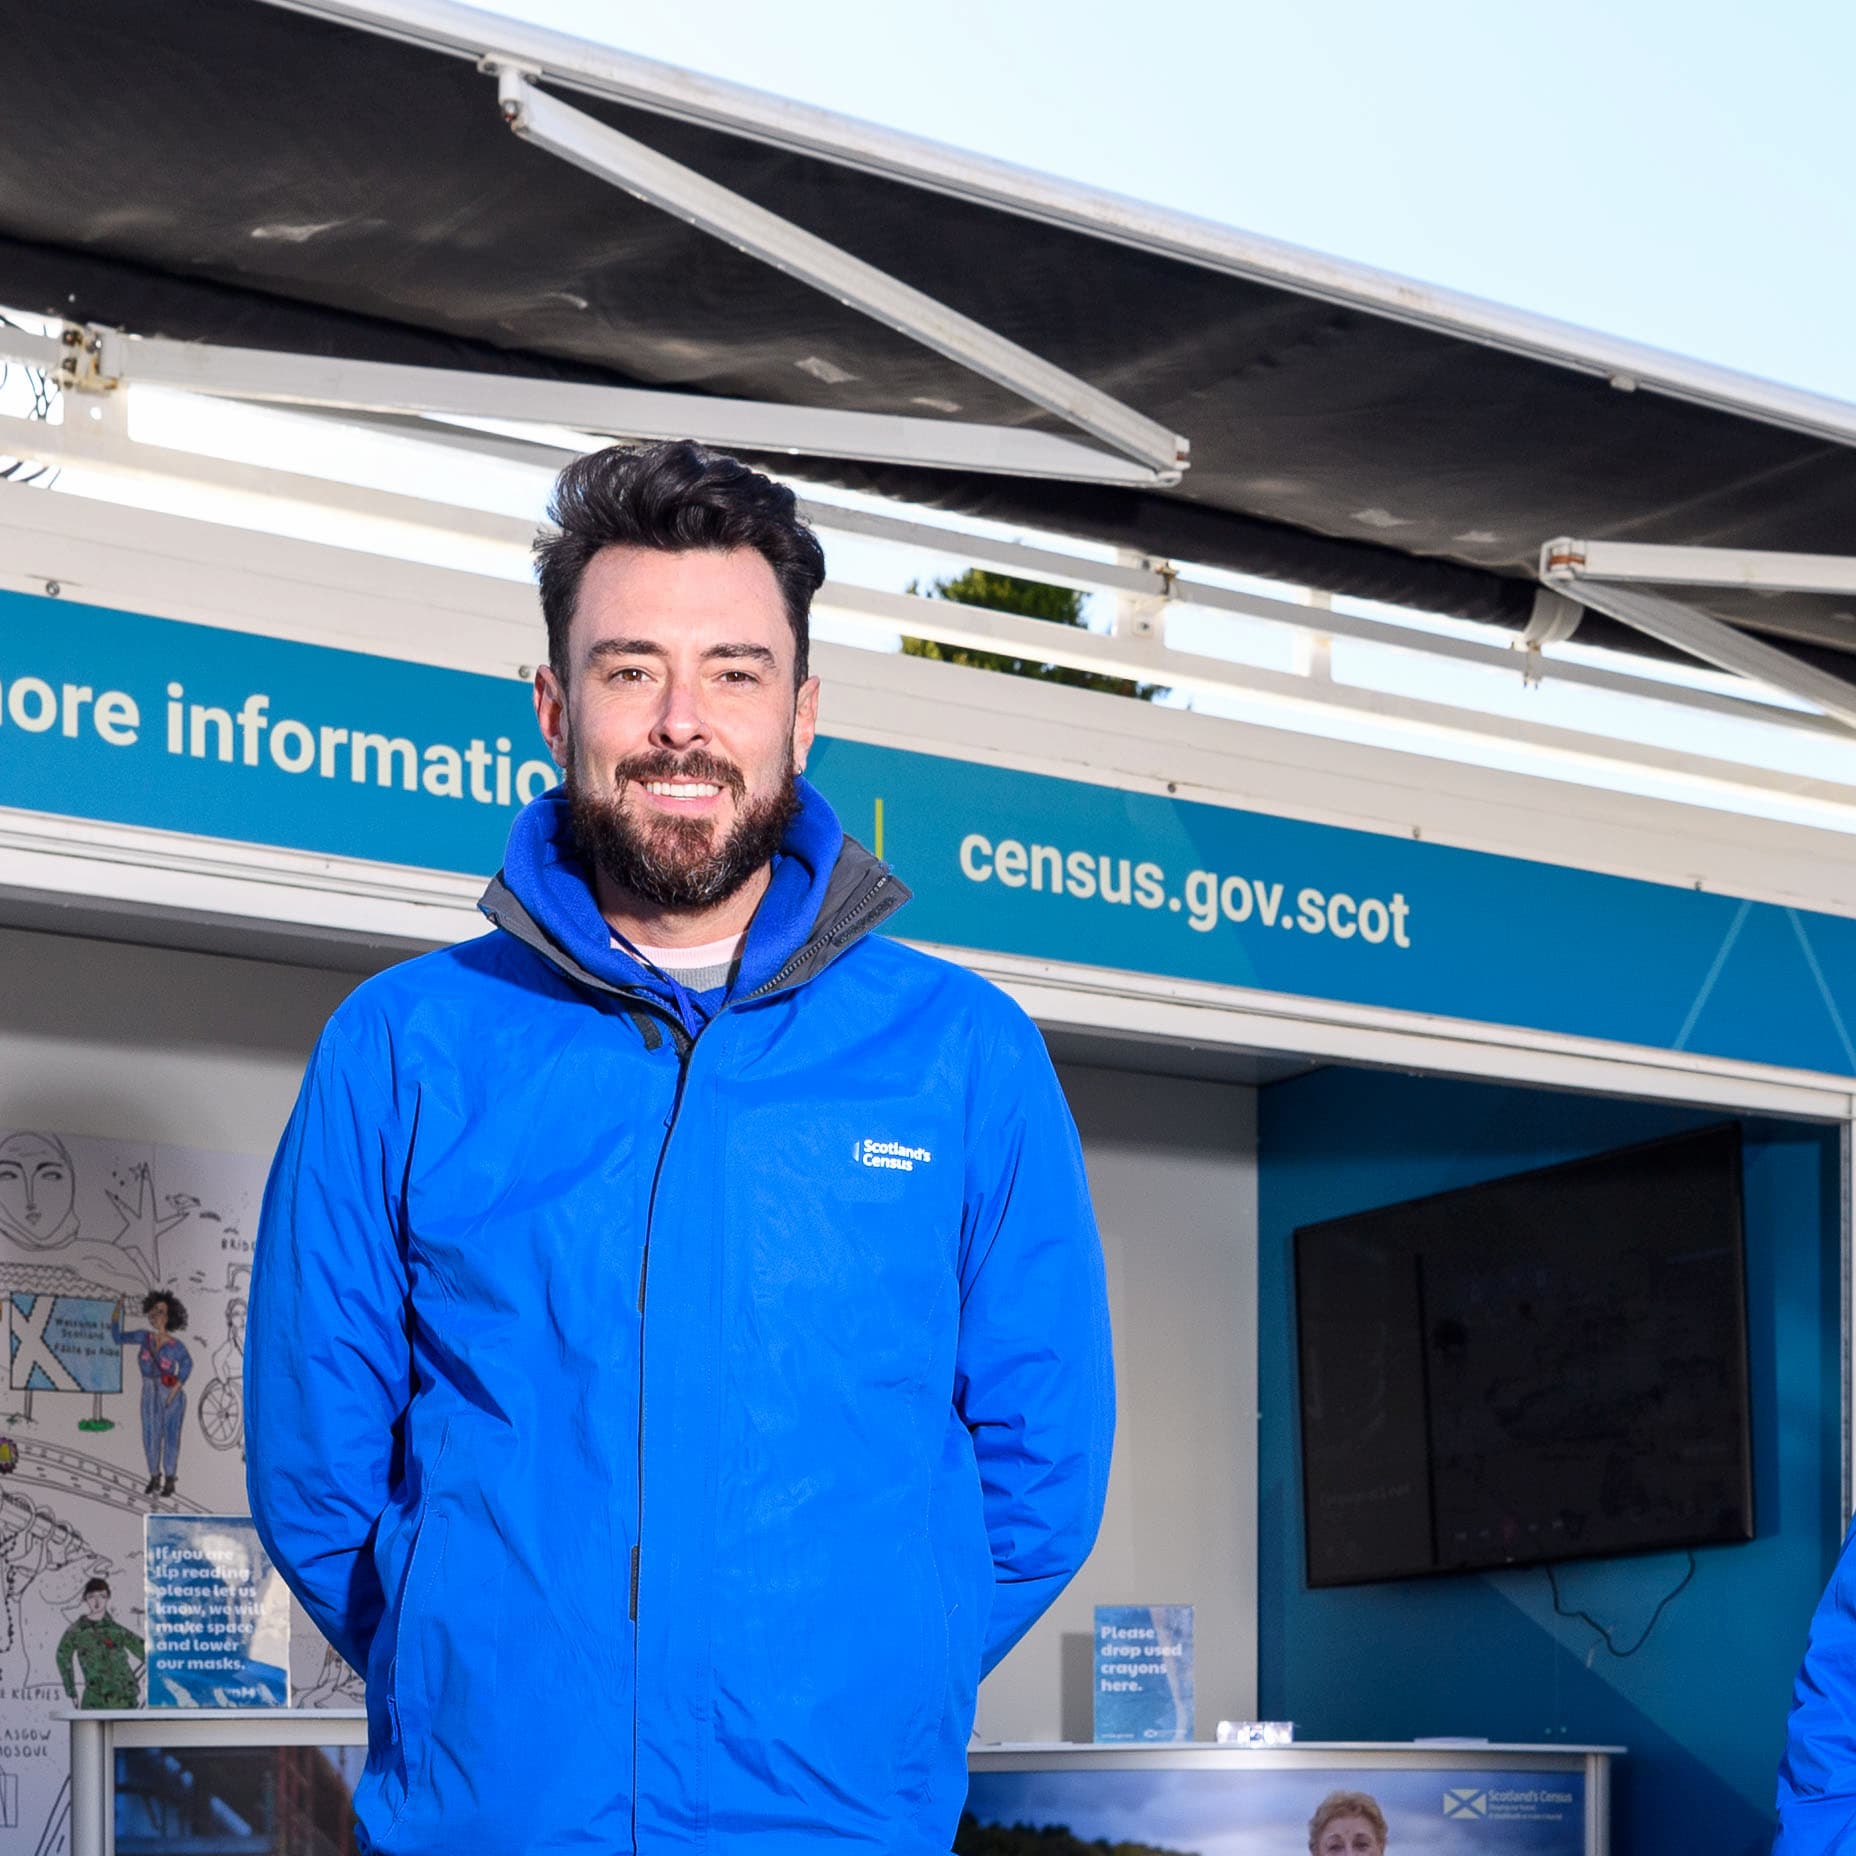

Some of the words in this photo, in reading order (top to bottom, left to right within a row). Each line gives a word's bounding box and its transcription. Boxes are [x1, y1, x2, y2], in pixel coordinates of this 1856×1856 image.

[166, 682, 565, 808] informatio
[959, 831, 1410, 950] census.gov.scot
[863, 1139, 931, 1163] Scotland's
[863, 1153, 913, 1172] Census
[156, 1546, 169, 1560] If
[172, 1549, 202, 1564] you
[205, 1550, 233, 1560] are
[156, 1564, 178, 1582] lip
[182, 1564, 249, 1582] reading
[156, 1584, 212, 1600] please
[214, 1584, 236, 1597] let
[239, 1586, 256, 1597] us
[156, 1603, 206, 1618] know,
[209, 1605, 232, 1615] we
[235, 1602, 266, 1615] will
[156, 1620, 204, 1633] make
[207, 1622, 254, 1637] space
[1100, 1626, 1155, 1639] Please
[156, 1638, 190, 1651] and
[193, 1638, 239, 1651] lower
[1100, 1643, 1142, 1659] drop
[1144, 1643, 1182, 1657] used
[156, 1658, 184, 1669] our
[187, 1657, 245, 1669] masks.
[1100, 1663, 1167, 1678] crayons
[1100, 1678, 1143, 1692] here.
